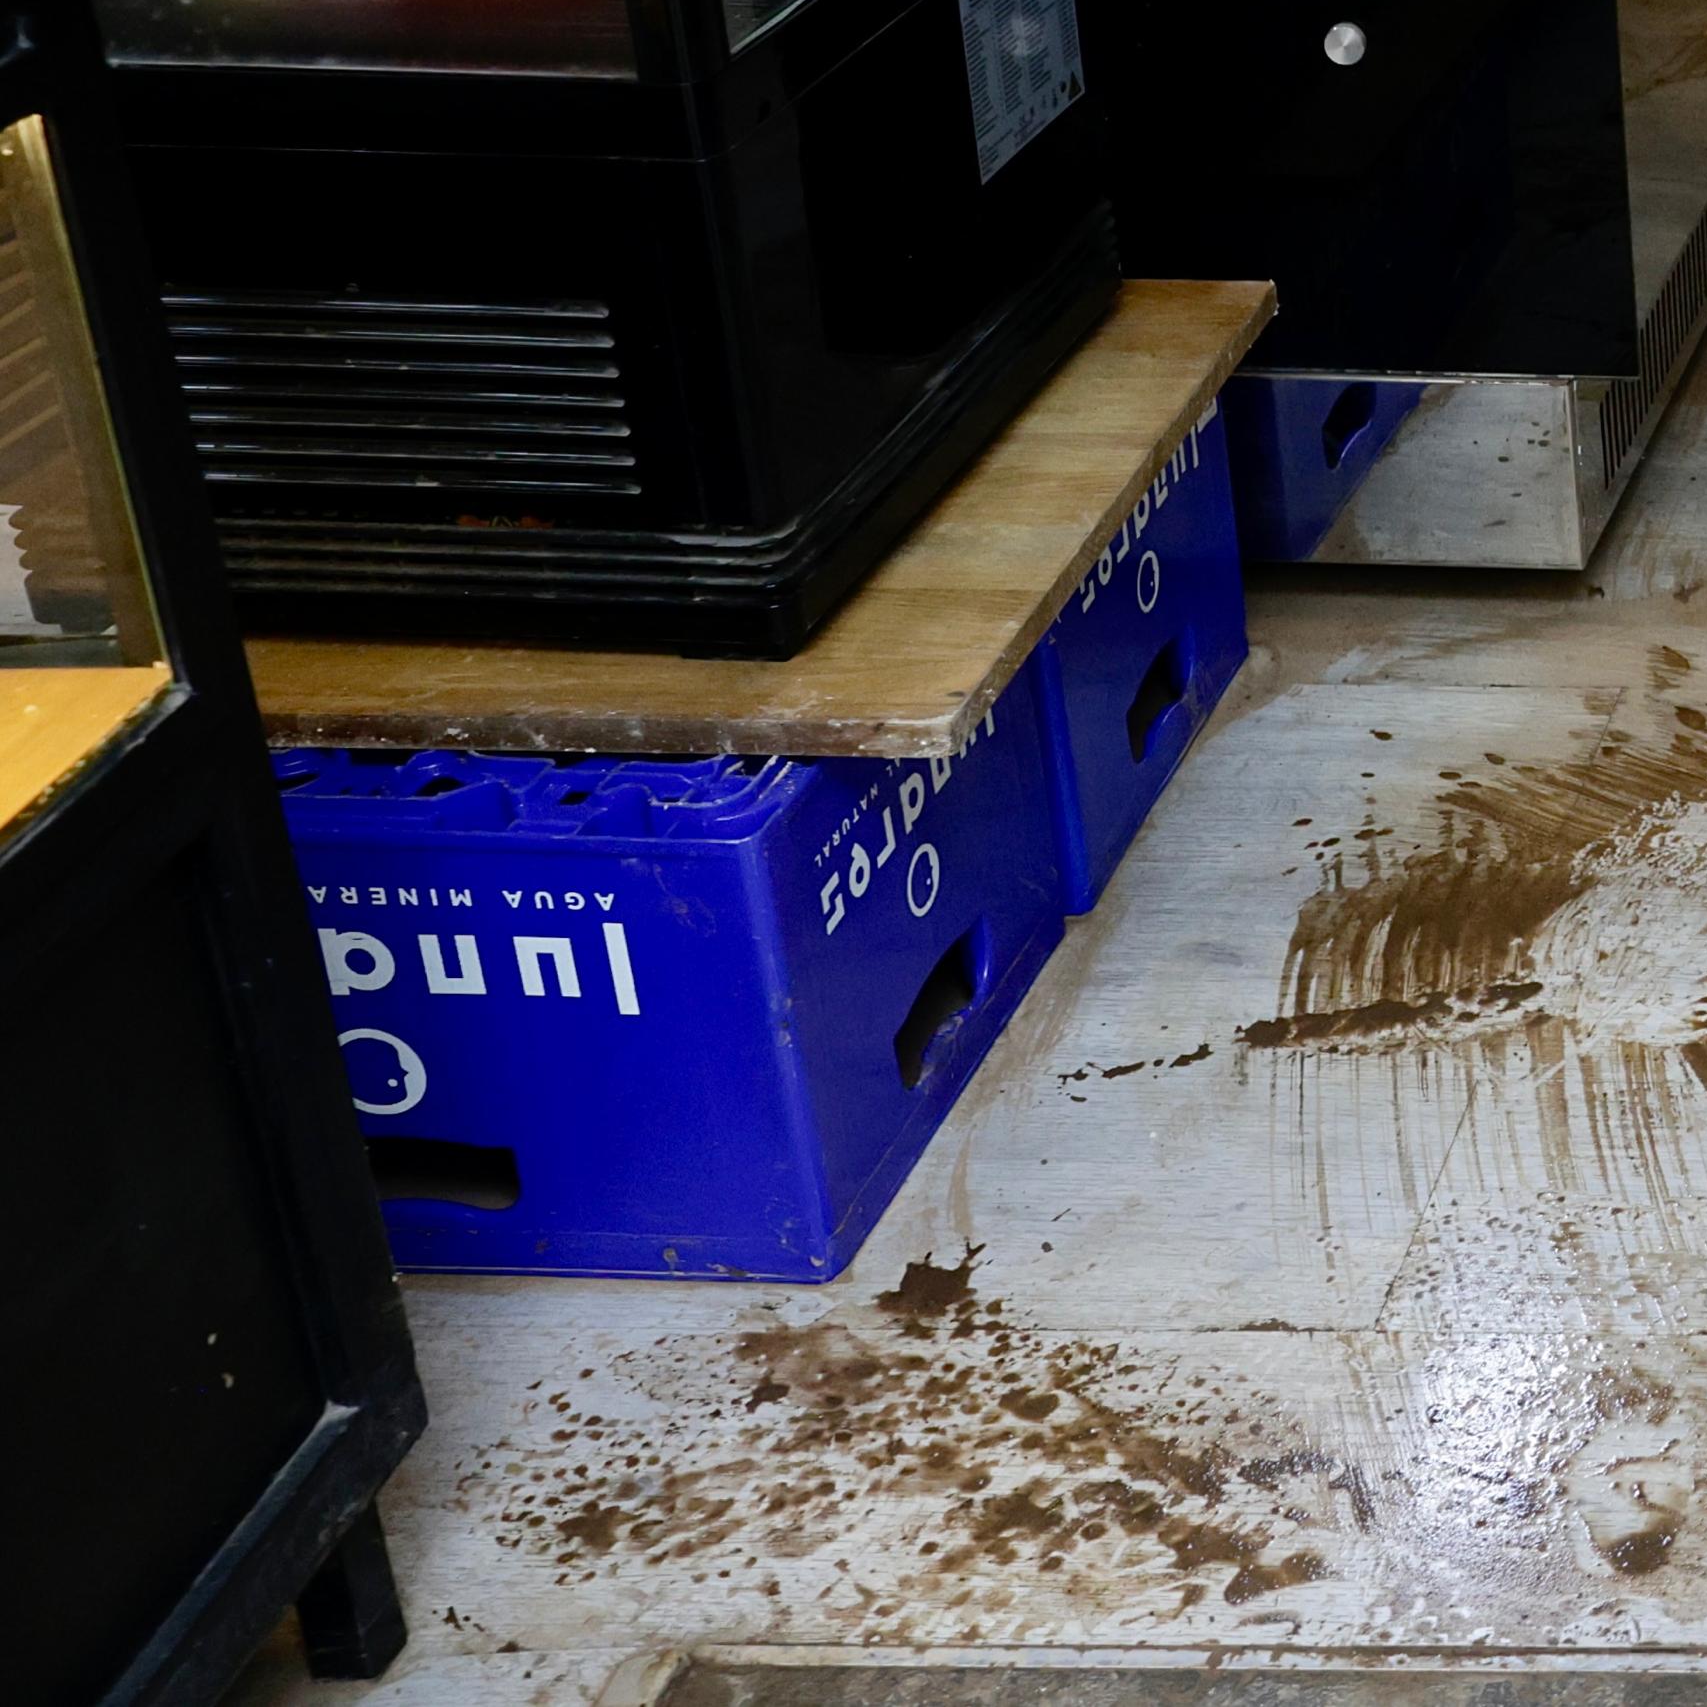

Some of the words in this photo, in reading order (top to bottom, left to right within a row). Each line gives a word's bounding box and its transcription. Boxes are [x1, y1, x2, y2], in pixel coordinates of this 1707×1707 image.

[814, 783, 878, 868] NATURAL
[307, 885, 473, 907] MINERA
[502, 889, 615, 912] AGUA
[317, 922, 641, 1016] luna
